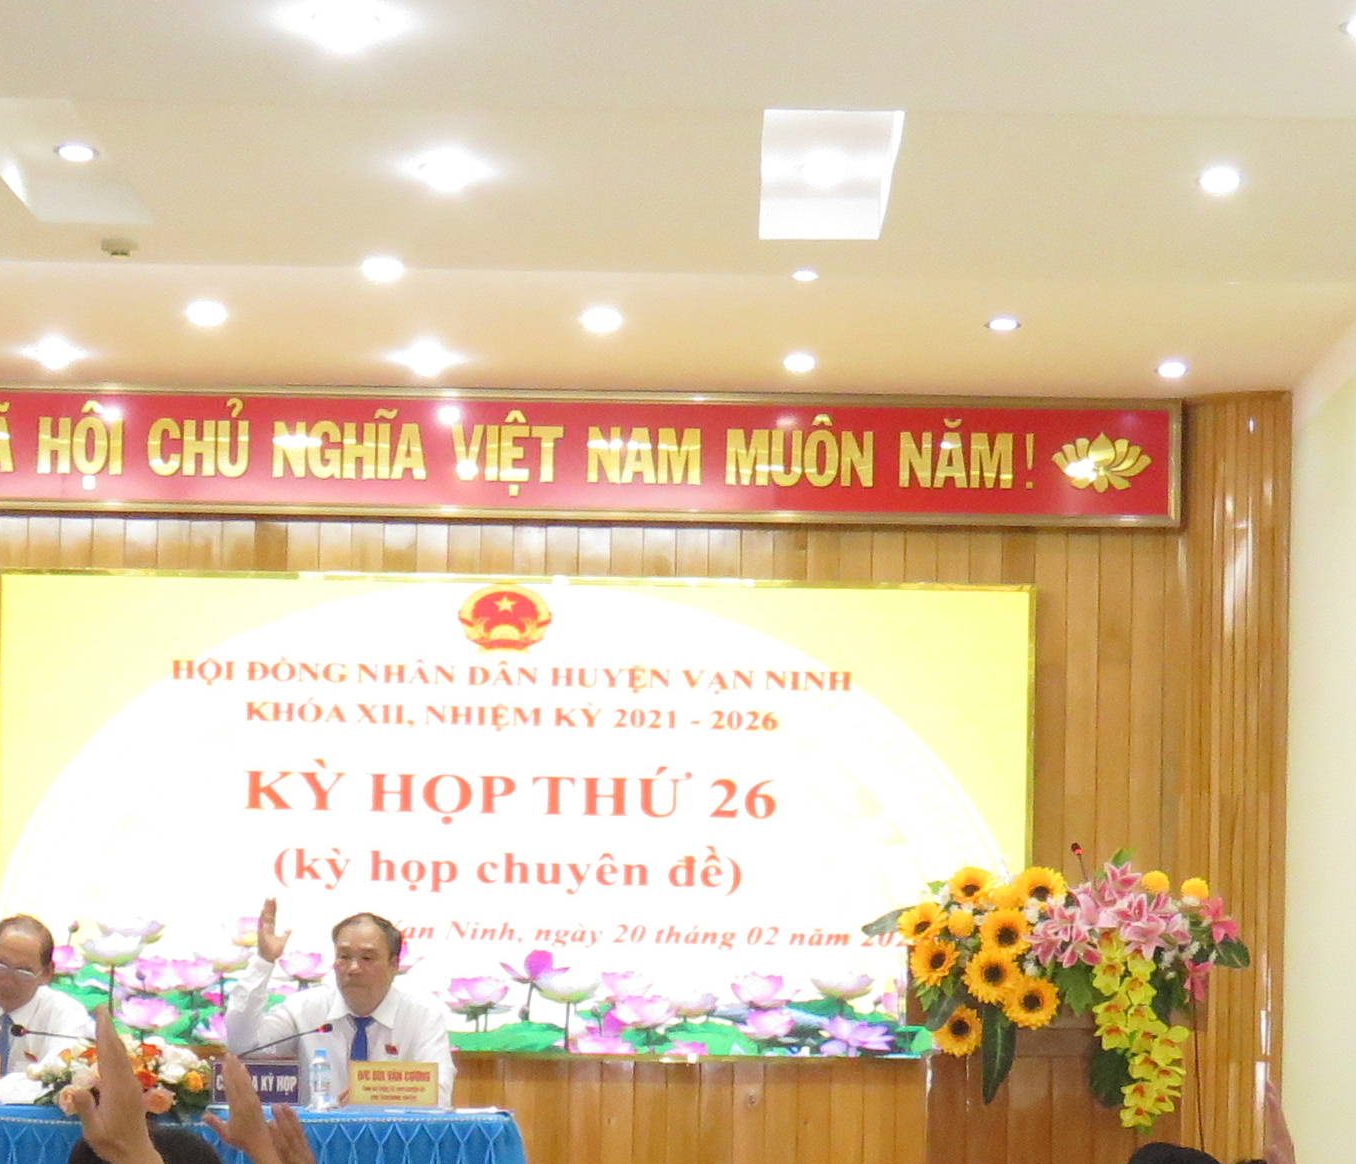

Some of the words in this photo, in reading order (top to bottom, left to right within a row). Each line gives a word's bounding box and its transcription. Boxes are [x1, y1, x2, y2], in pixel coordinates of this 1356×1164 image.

[36, 400, 123, 490] HỘI
[147, 398, 250, 478] CHỦ
[272, 408, 427, 480] NGHĨA
[450, 410, 564, 496] VIỆT
[587, 426, 702, 485] NAM
[725, 413, 874, 488] MUÔN
[171, 657, 235, 686] HỘI
[357, 659, 455, 685] NHÂN
[467, 660, 538, 686] DÂN
[550, 665, 670, 693] HUYỆN
[682, 669, 754, 695] VẠN
[765, 670, 853, 692] NINH
[245, 697, 347, 723] KHÓA
[356, 704, 415, 728] XII,
[425, 704, 542, 732] NHIỆM
[554, 702, 602, 729] KỲ
[613, 708, 676, 730] 2021
[710, 710, 779, 732] 2026
[244, 758, 347, 811] KỲ
[369, 773, 517, 825] HỌP
[531, 766, 693, 819] THỨ
[709, 778, 777, 820] 26
[273, 847, 351, 891] (kỳ
[370, 850, 459, 893] họp
[476, 852, 649, 896] chuyên
[667, 845, 743, 897] đề)
[446, 920, 523, 943] Ninh,
[535, 923, 603, 949] ngày
[612, 924, 647, 944] 20
[654, 925, 737, 950] tháng
[746, 926, 780, 946] 02
[788, 928, 851, 947] năm
[276, 1075, 297, 1095] HỌP
